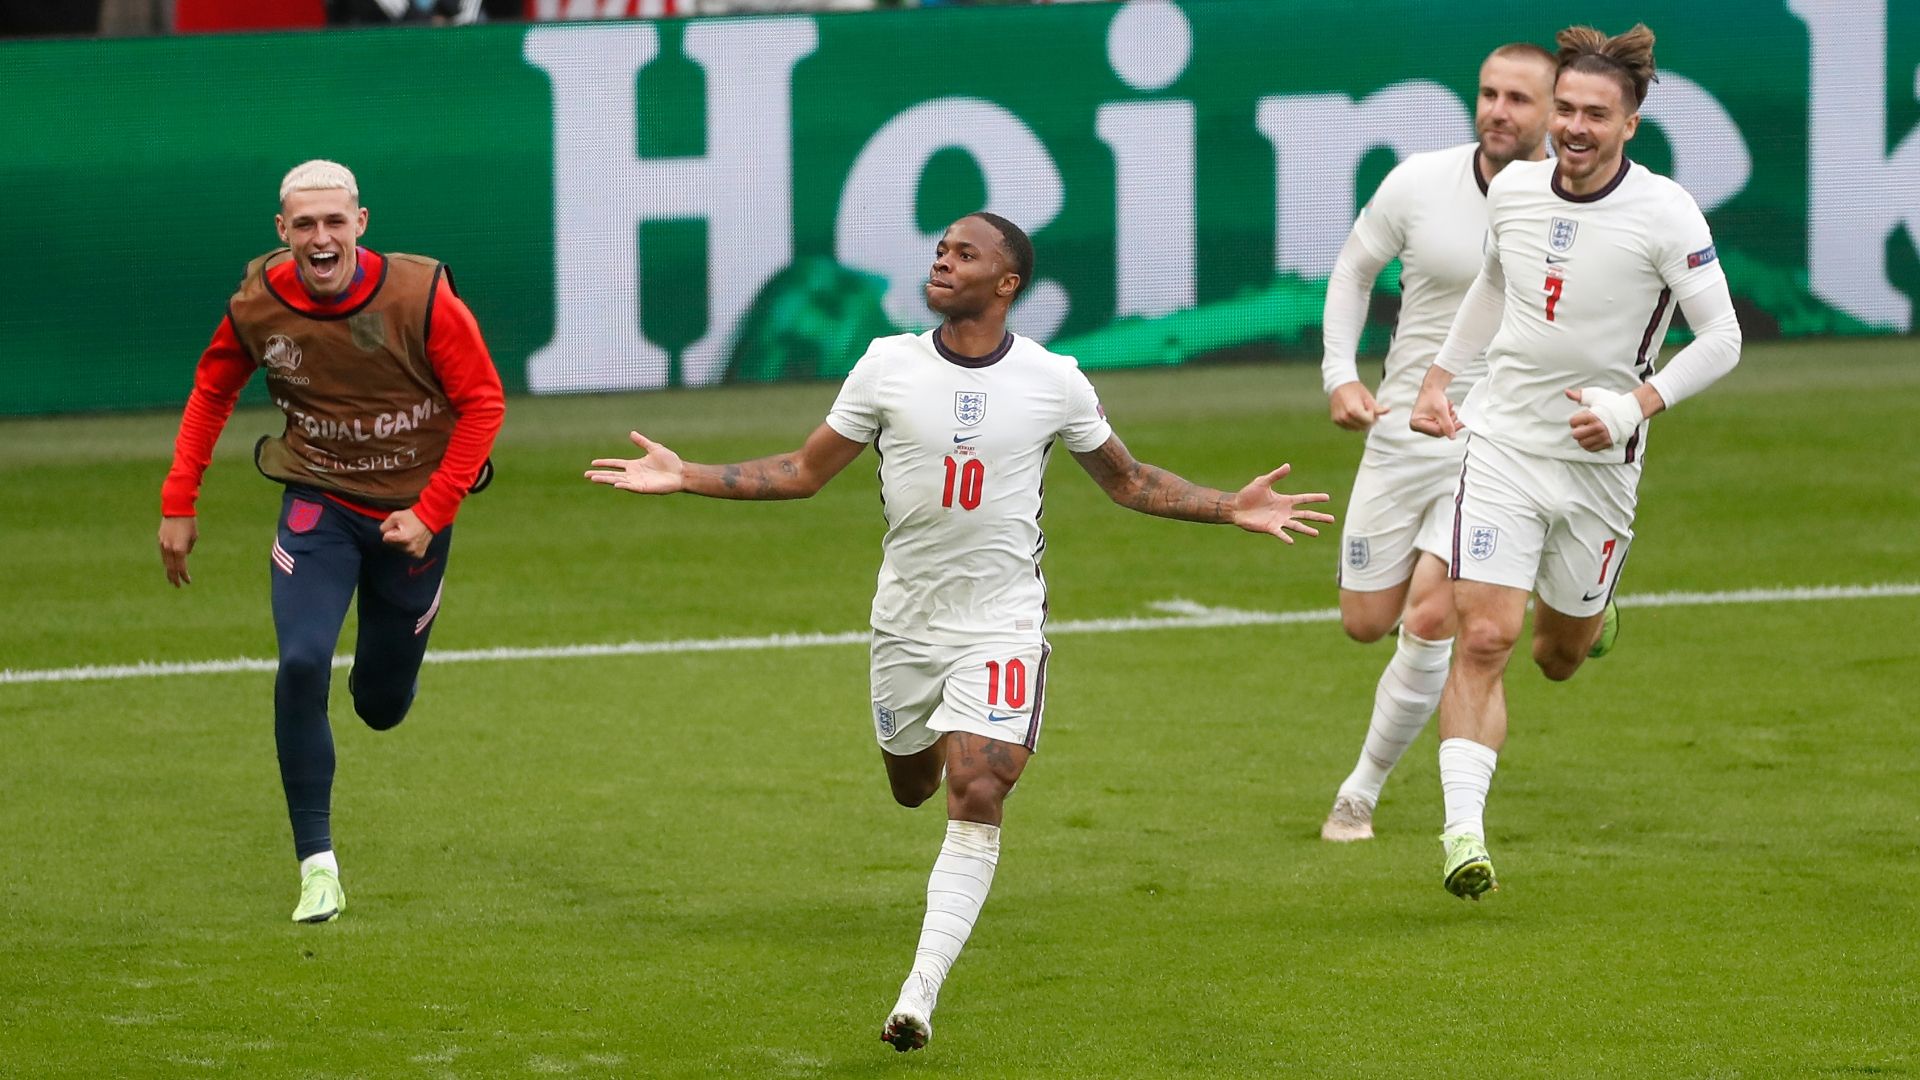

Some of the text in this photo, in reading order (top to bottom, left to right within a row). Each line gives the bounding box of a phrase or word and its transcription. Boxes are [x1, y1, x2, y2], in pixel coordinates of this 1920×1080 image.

[1543, 276, 1563, 321] 7
[941, 455, 985, 511] 10
[1598, 539, 1616, 584] 7
[986, 657, 1026, 709] 10
